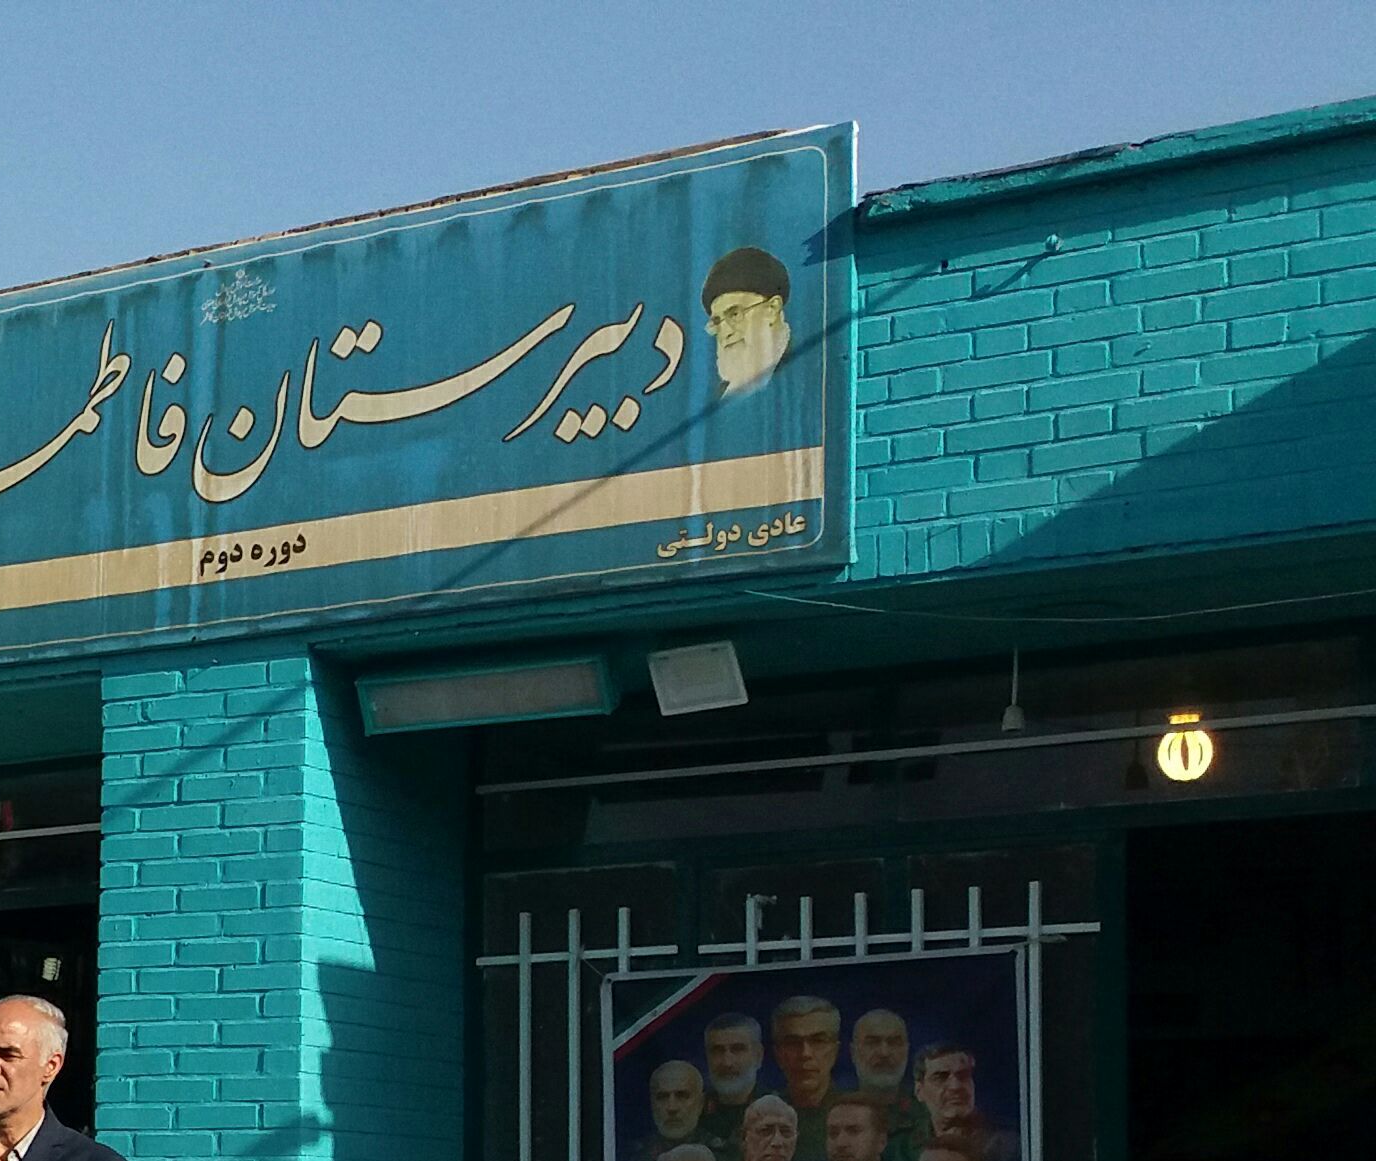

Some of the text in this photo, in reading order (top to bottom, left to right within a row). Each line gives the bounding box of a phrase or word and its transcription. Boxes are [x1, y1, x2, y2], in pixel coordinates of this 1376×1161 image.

[193, 299, 685, 502] دبیرستان
[199, 533, 307, 577] دوره دوم
[656, 511, 807, 558] عادی دولتی
